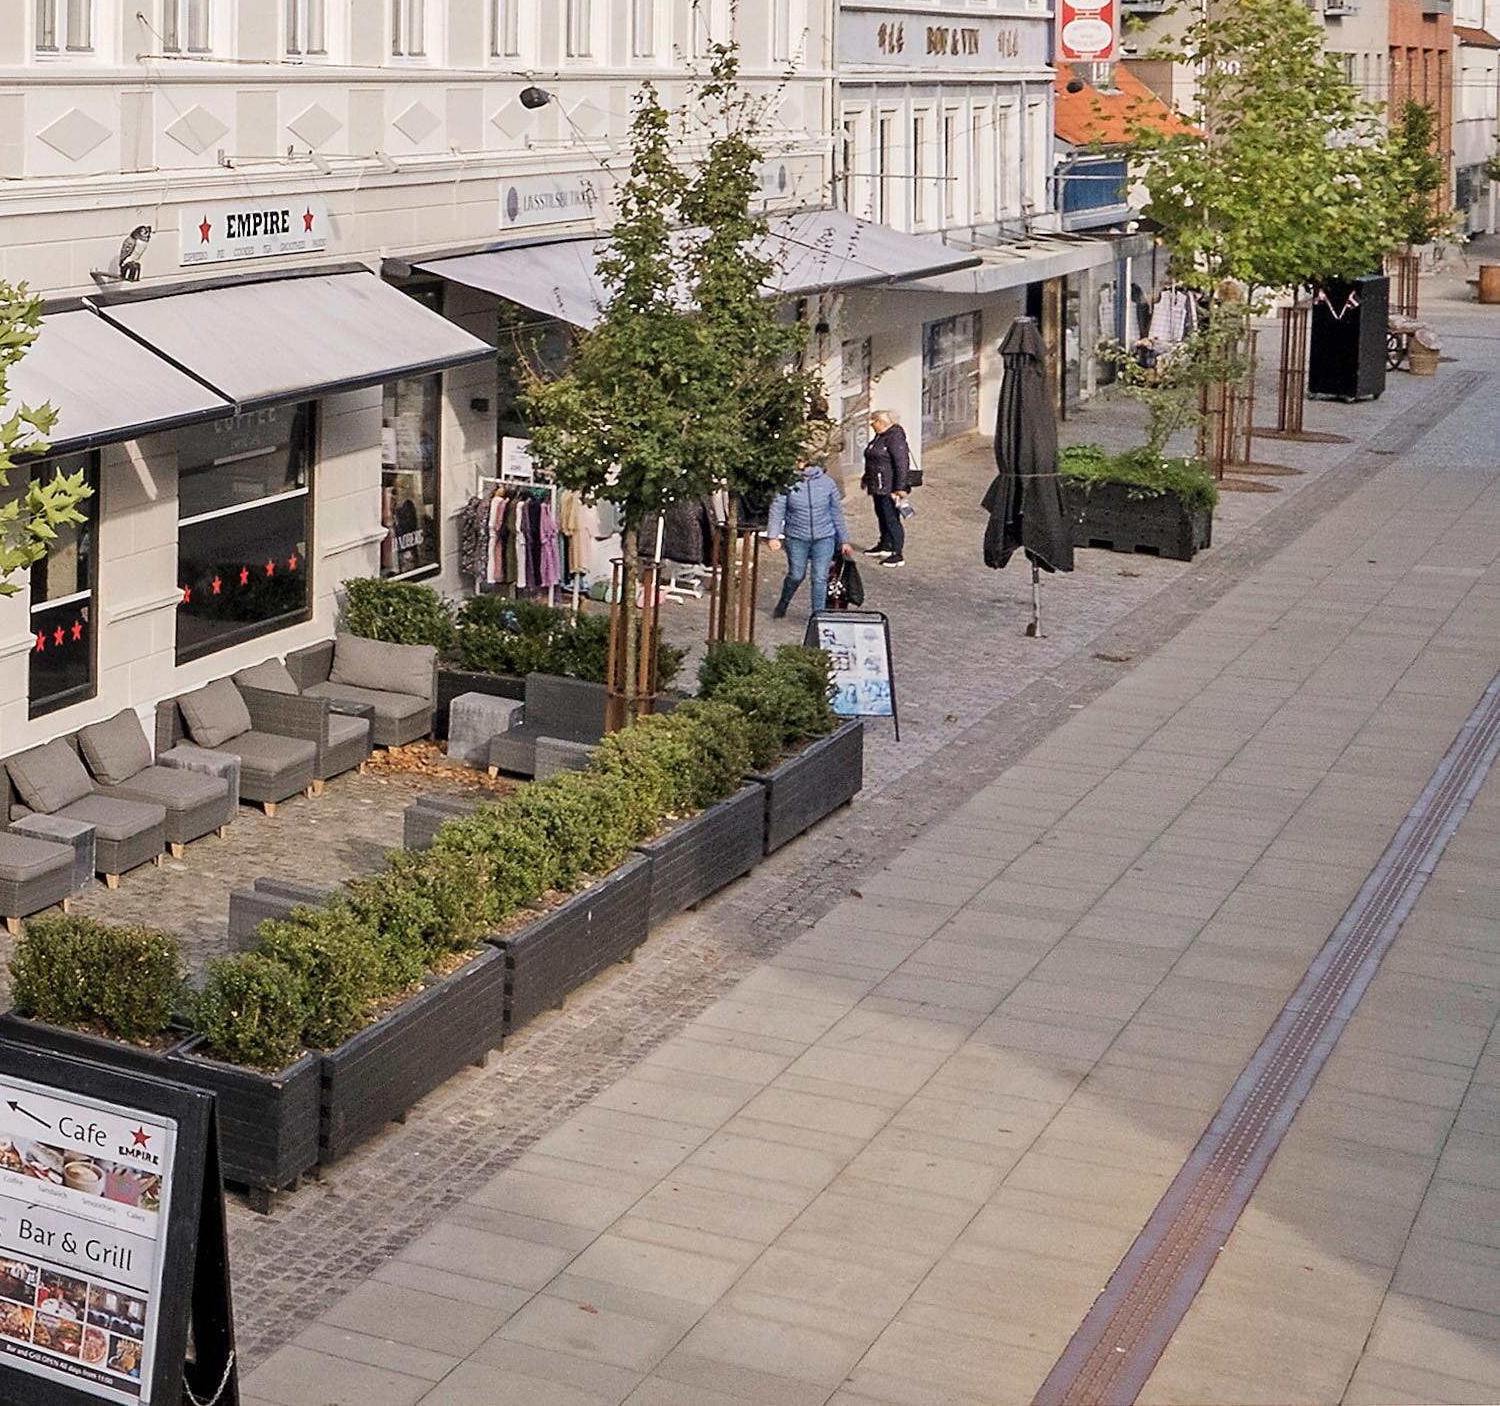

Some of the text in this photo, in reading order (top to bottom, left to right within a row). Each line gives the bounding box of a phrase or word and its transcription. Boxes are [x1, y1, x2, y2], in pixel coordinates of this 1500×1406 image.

[226, 210, 290, 239] EMPIRE
[58, 1116, 108, 1148] Cafe
[118, 1145, 159, 1166] EMPIRE
[18, 1218, 56, 1246] Bar
[61, 1232, 78, 1255] &
[85, 1239, 132, 1272] Grill
